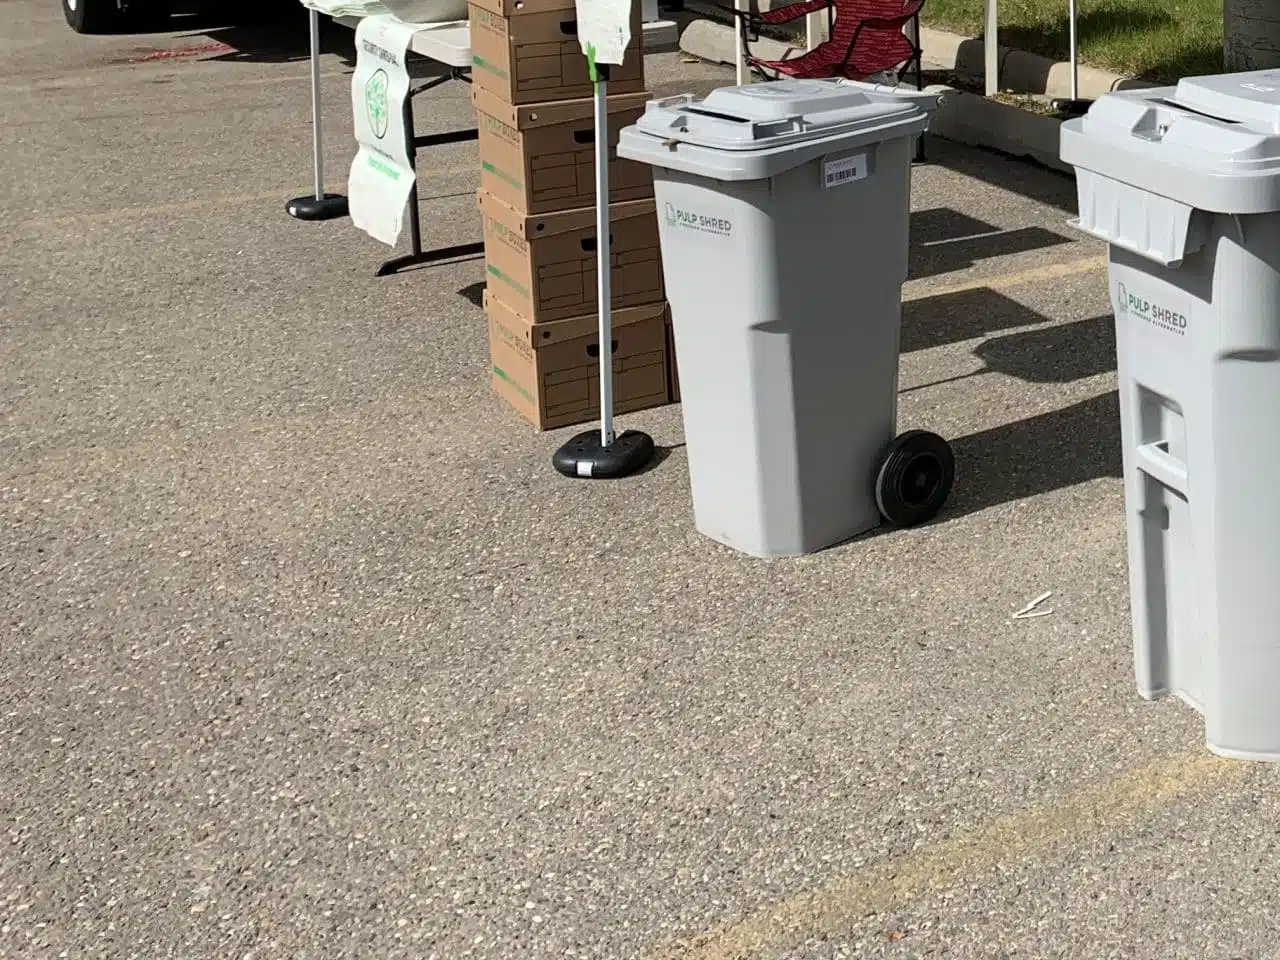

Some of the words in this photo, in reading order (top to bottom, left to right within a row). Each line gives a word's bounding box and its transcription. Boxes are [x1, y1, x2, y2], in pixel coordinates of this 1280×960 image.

[676, 210, 697, 224] PULP
[699, 215, 732, 232] SHRED
[1129, 294, 1150, 313] PULP
[1152, 304, 1187, 329] SHRED
